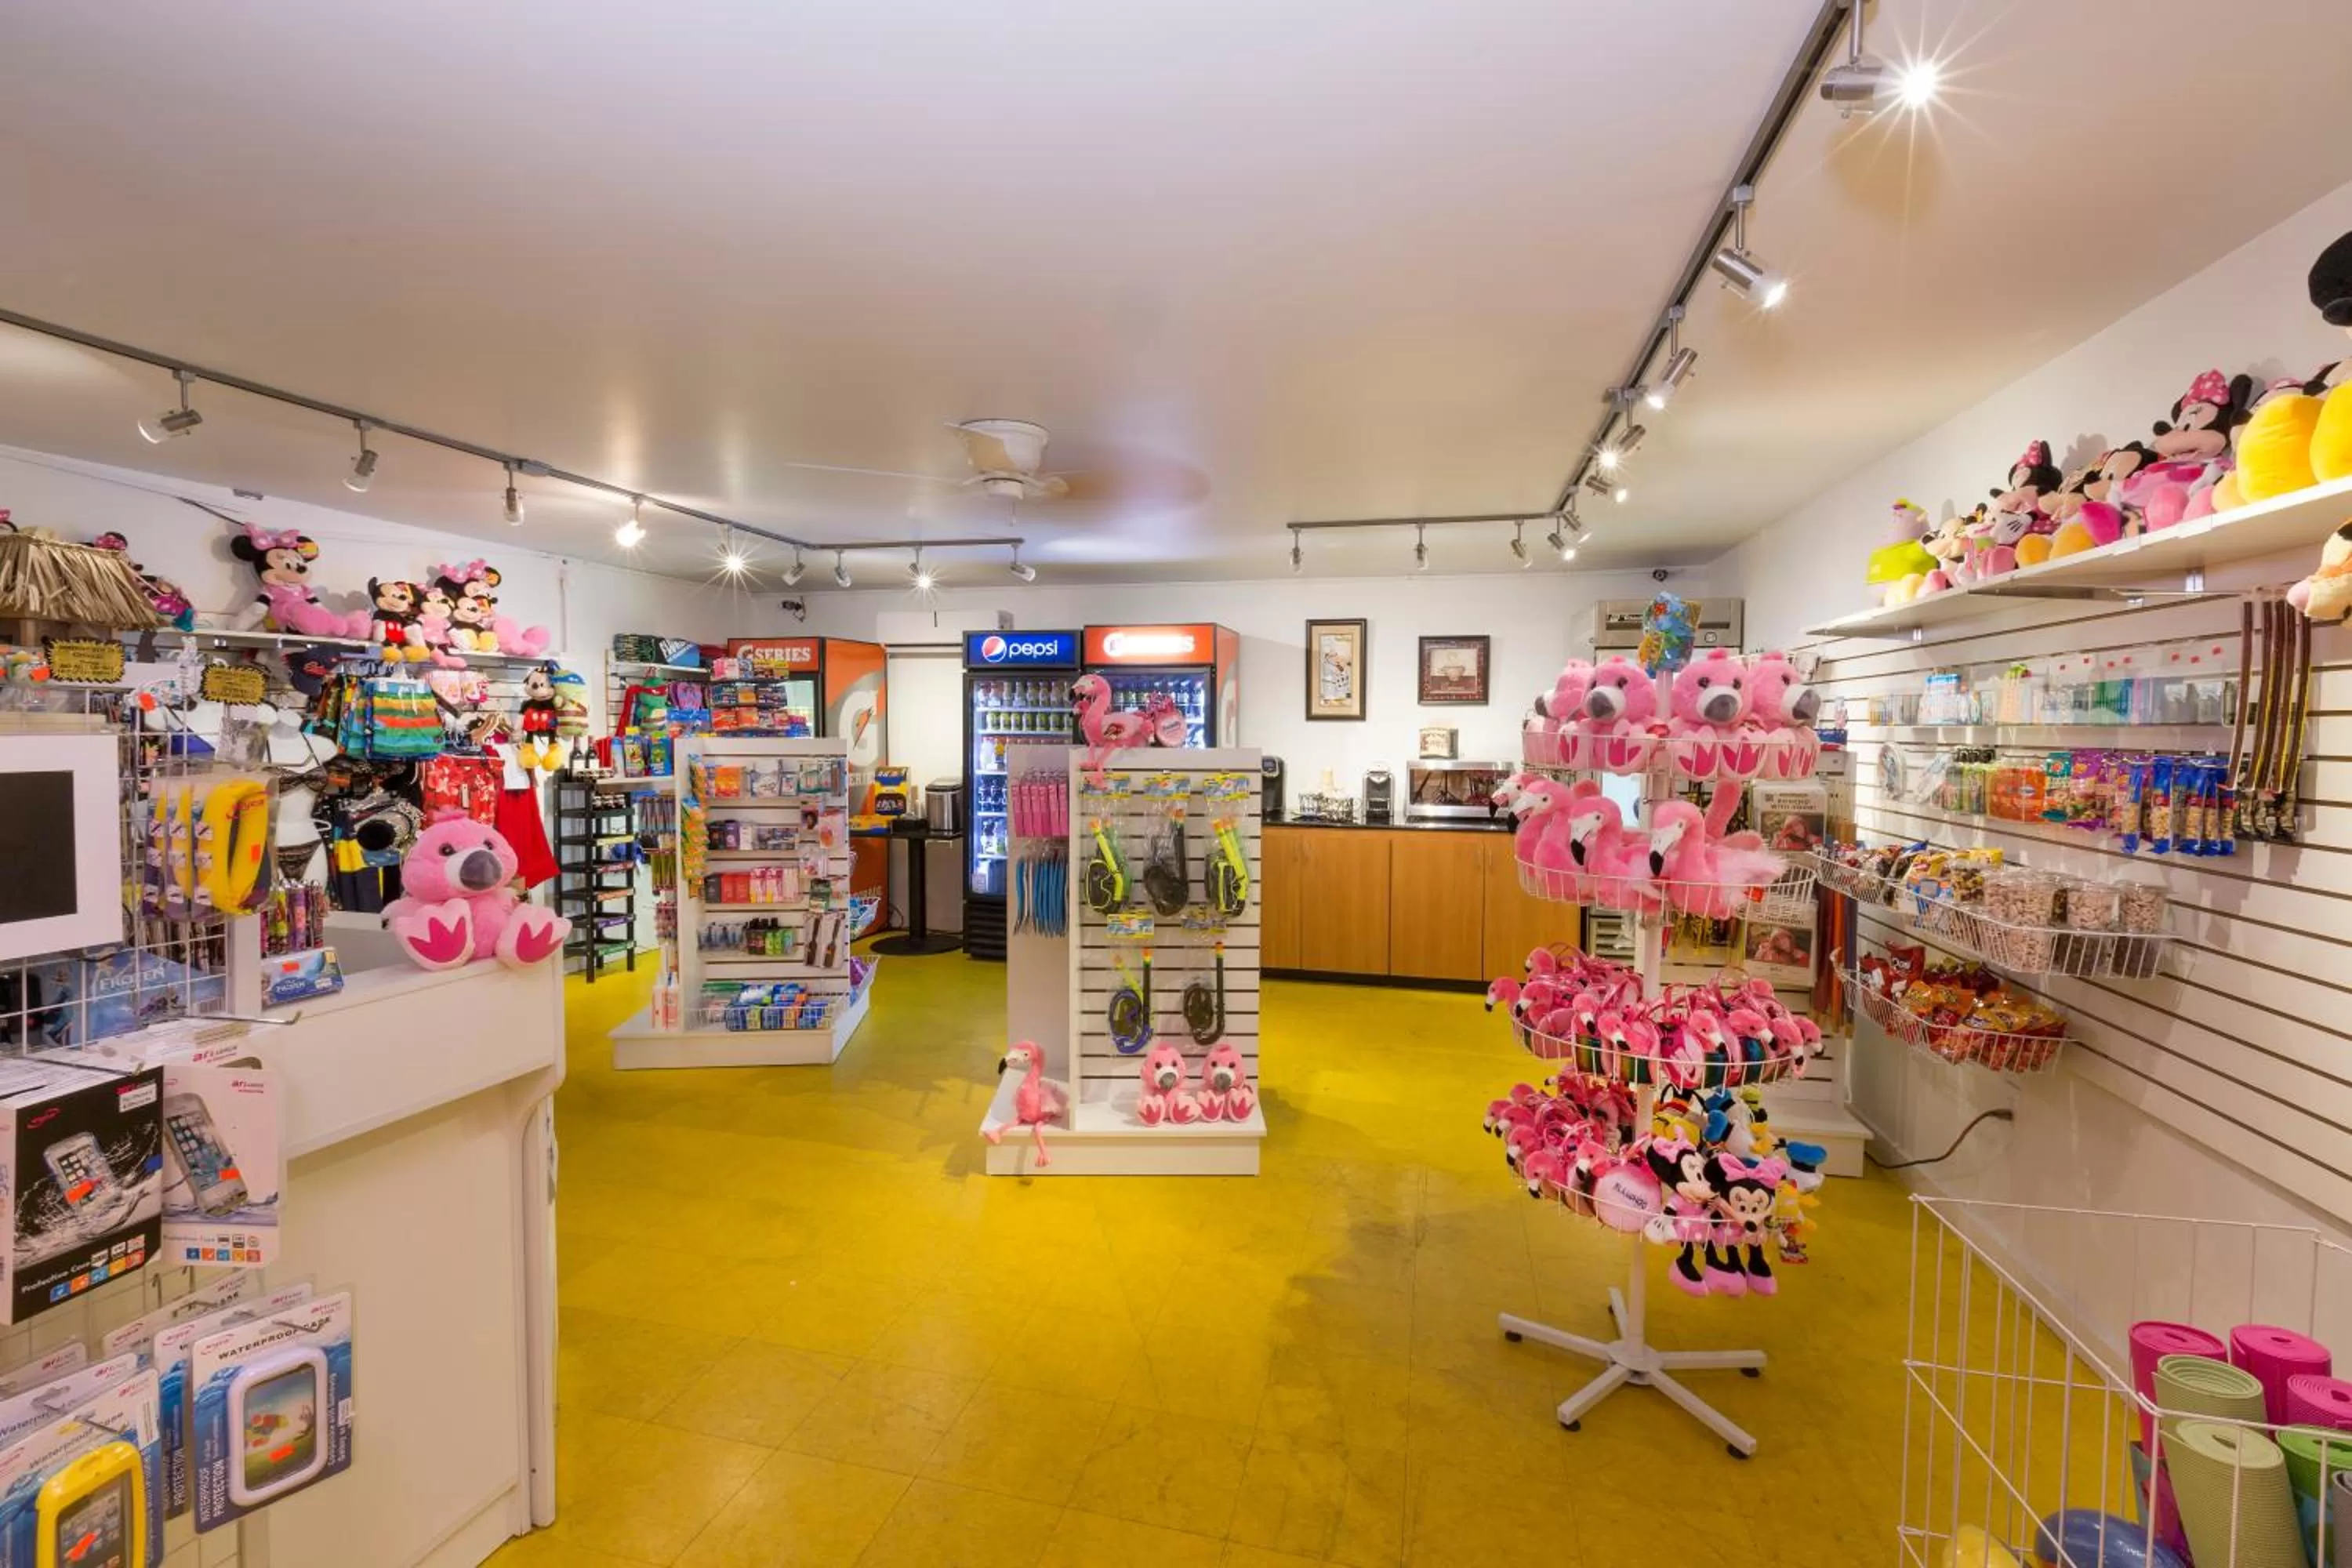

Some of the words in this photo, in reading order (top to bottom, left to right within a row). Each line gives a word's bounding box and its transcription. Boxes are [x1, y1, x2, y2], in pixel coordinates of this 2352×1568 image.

[754, 646, 812, 662] SERIES
[1008, 639, 1058, 659] pepsi
[217, 1327, 299, 1360] WATERPROOF
[212, 1458, 226, 1518] PROTECTION
